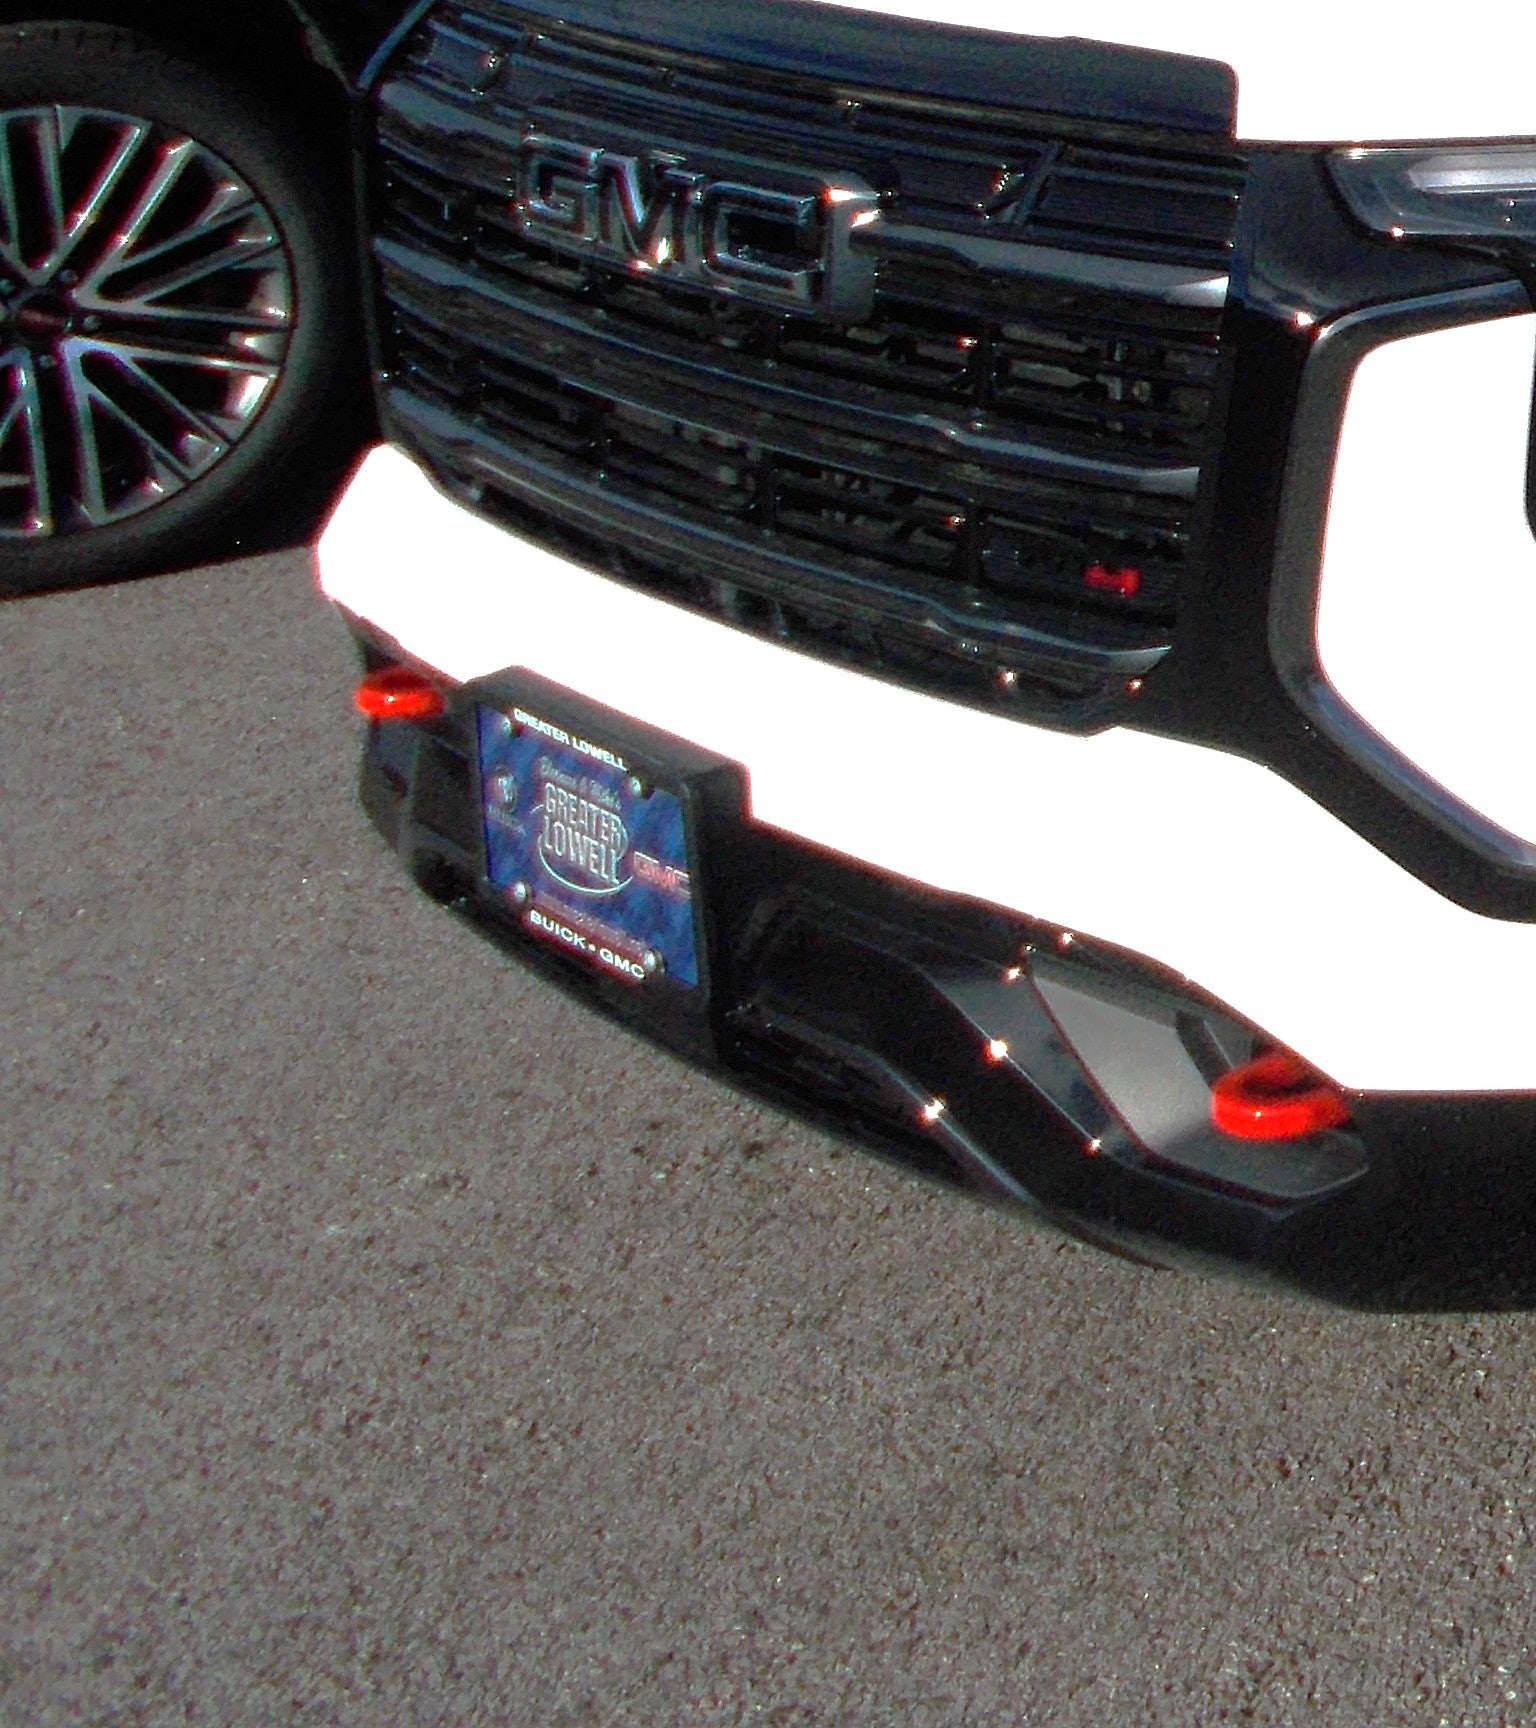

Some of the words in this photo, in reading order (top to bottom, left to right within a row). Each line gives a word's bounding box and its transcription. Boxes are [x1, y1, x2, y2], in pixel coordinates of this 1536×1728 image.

[518, 129, 850, 314] GMC
[513, 707, 570, 746] GREATER
[572, 735, 628, 772] LOWELL
[543, 782, 623, 849] GREATER
[543, 815, 621, 886] LOWELL
[529, 908, 587, 949] BUICK
[599, 947, 645, 979] GMC
